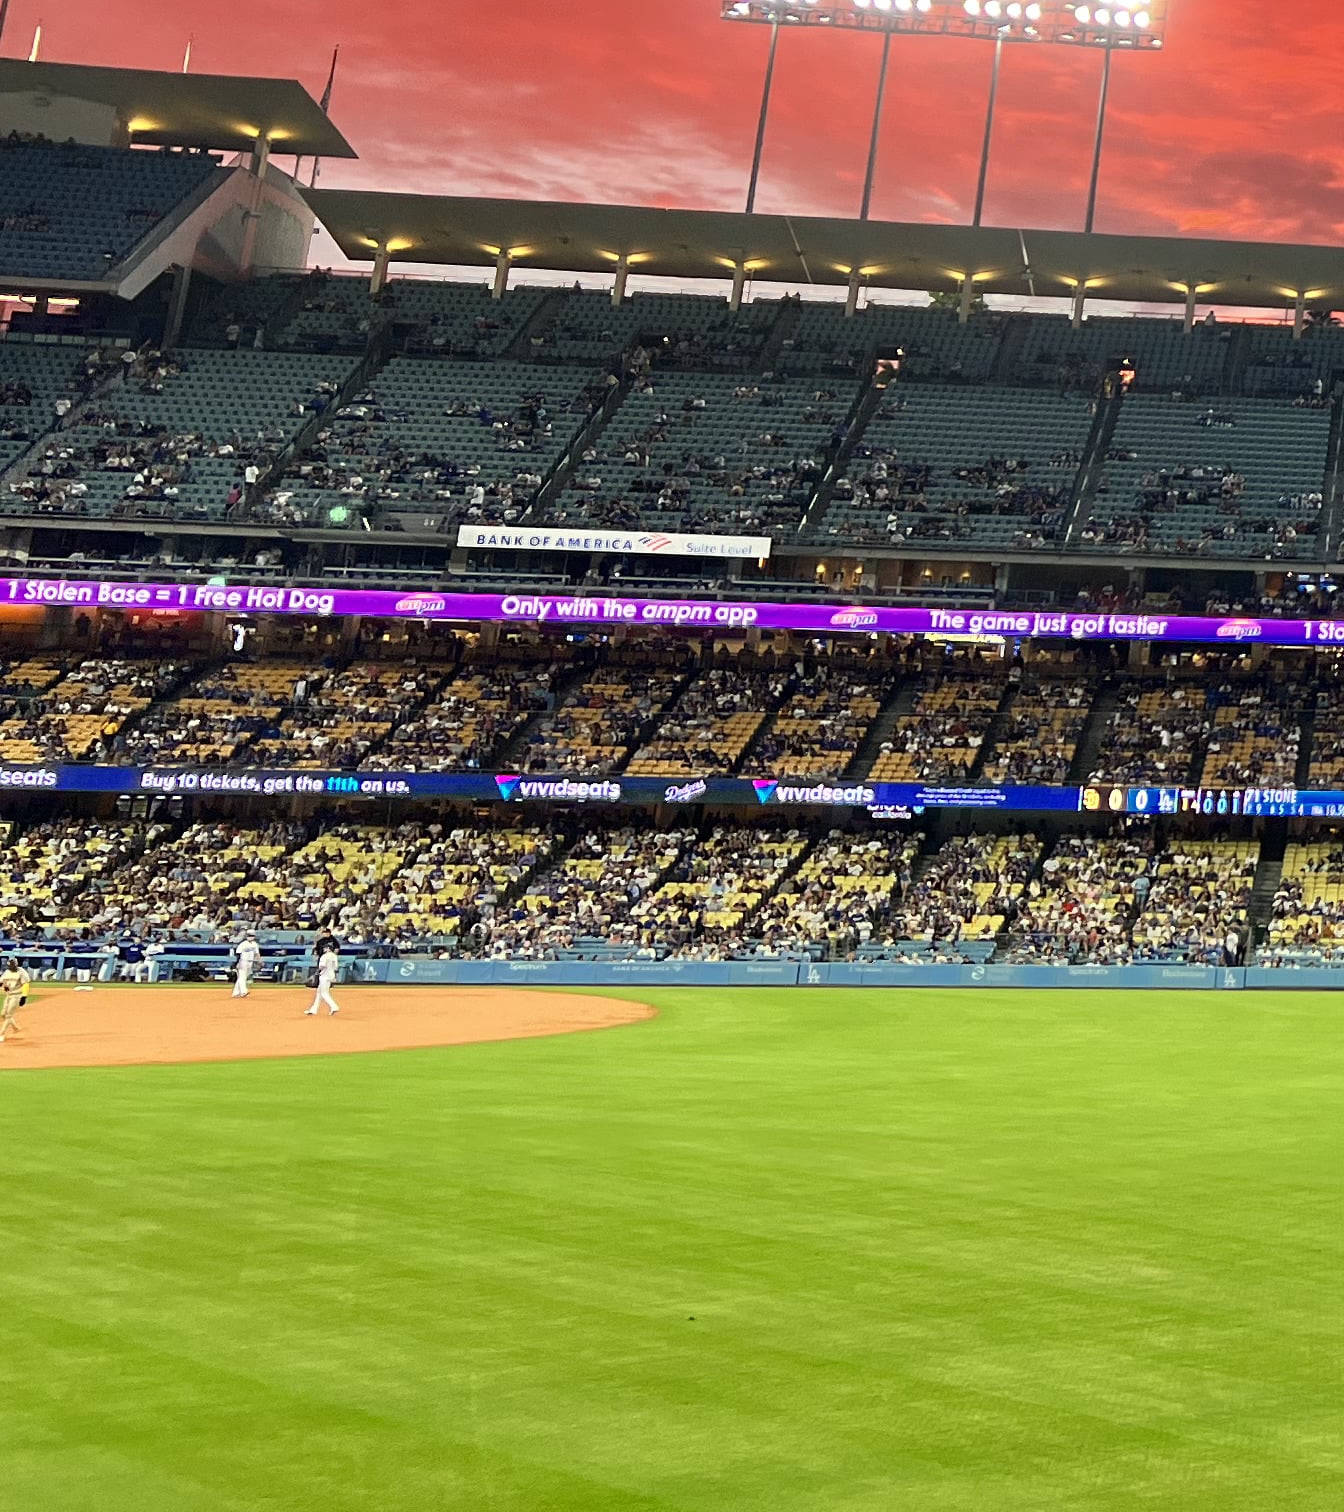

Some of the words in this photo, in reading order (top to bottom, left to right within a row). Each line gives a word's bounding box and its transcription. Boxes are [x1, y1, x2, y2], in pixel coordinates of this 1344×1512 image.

[476, 534, 524, 547] BANK
[529, 536, 551, 548] OF
[555, 537, 633, 550] AMERICA
[686, 542, 717, 554] Suite
[720, 543, 752, 556] Level
[8, 581, 17, 599] 1
[24, 582, 91, 601] Stolen
[98, 583, 150, 603] Base
[178, 586, 187, 604] 1
[194, 587, 242, 606] Free
[247, 589, 284, 608] Hot
[289, 591, 334, 613] Dog
[501, 597, 548, 620] Only
[557, 598, 598, 618] with
[603, 599, 636, 618] the
[642, 602, 712, 622] ampm
[715, 606, 757, 626] app
[930, 609, 964, 630] The
[969, 612, 1029, 634] game
[1033, 613, 1066, 636] just
[1071, 615, 1104, 639] got
[1109, 615, 1167, 635] tastier
[1303, 621, 1312, 639] 1
[142, 773, 175, 791] Buy
[177, 774, 198, 788] 10
[200, 774, 260, 792] tickets,
[264, 776, 293, 794] get
[296, 776, 323, 791] the
[327, 778, 358, 792] 11th
[361, 779, 382, 791] on
[385, 780, 410, 793] us.
[520, 779, 621, 798] vividseats
[775, 783, 875, 803] vividseats
[1109, 789, 1122, 811] 0
[1136, 789, 1147, 810] 0
[1263, 789, 1297, 804] STONE
